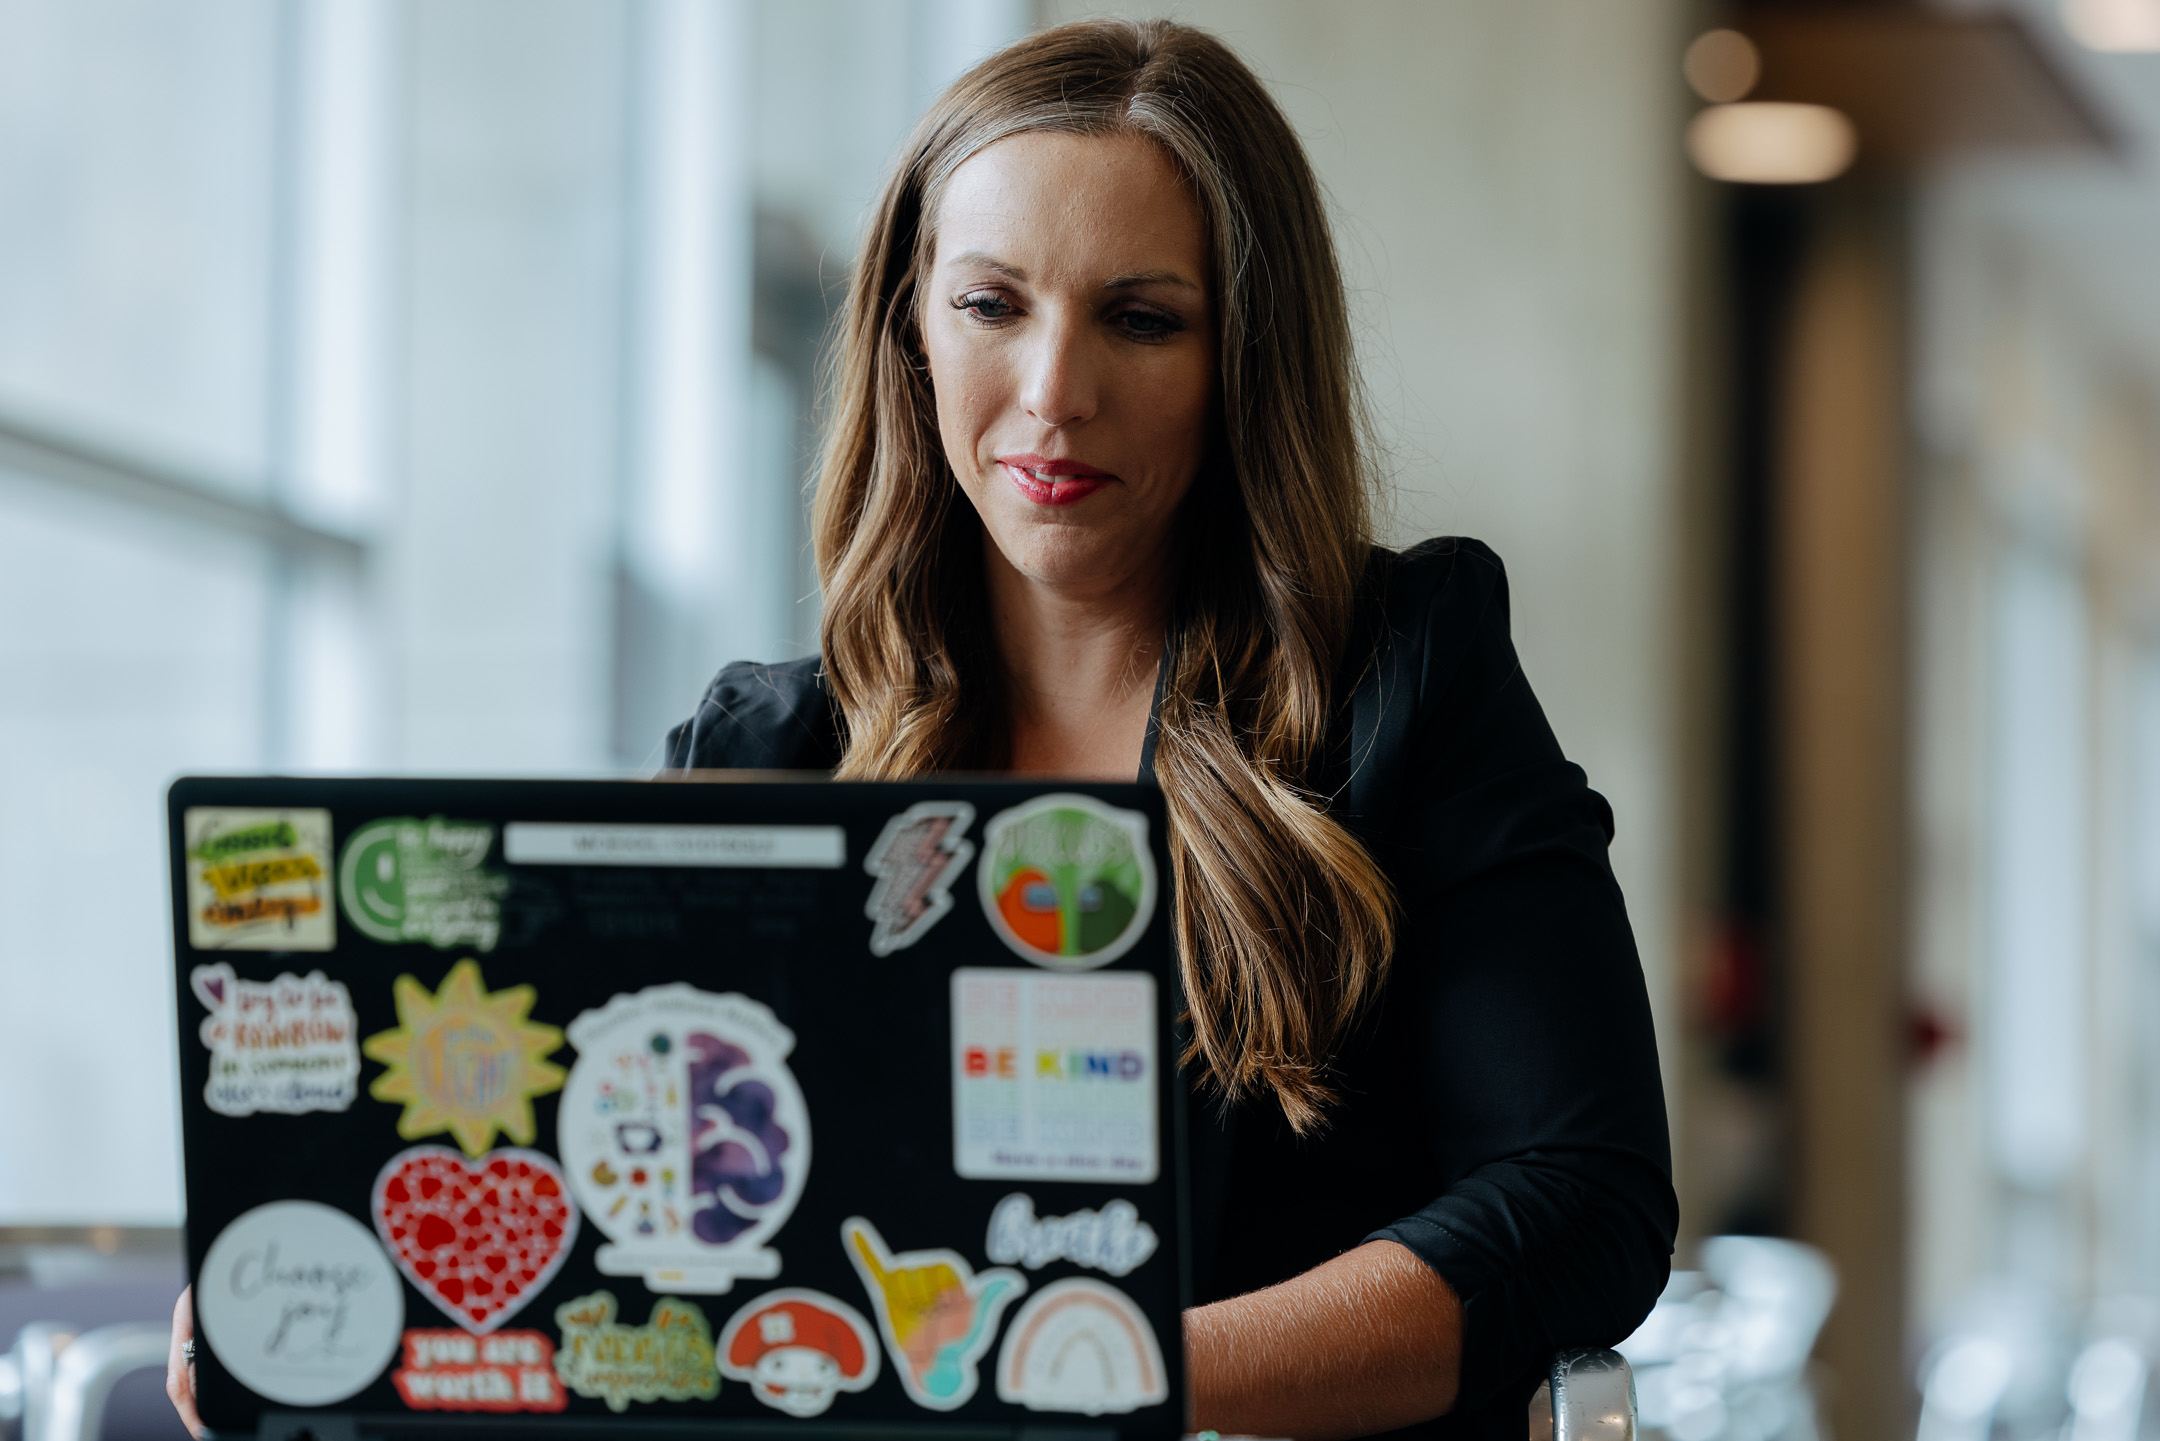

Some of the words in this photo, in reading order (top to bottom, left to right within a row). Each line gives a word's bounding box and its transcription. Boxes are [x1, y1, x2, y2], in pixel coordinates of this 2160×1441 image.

[233, 1018, 350, 1053] RAINBOW
[964, 1045, 1020, 1079] BE
[1035, 1046, 1145, 1080] KIND
[229, 1239, 374, 1298] Choose
[266, 1297, 350, 1357] joy
[410, 1333, 478, 1369] you
[481, 1335, 545, 1367] are
[403, 1366, 516, 1402] worth
[518, 1366, 556, 1403] it
